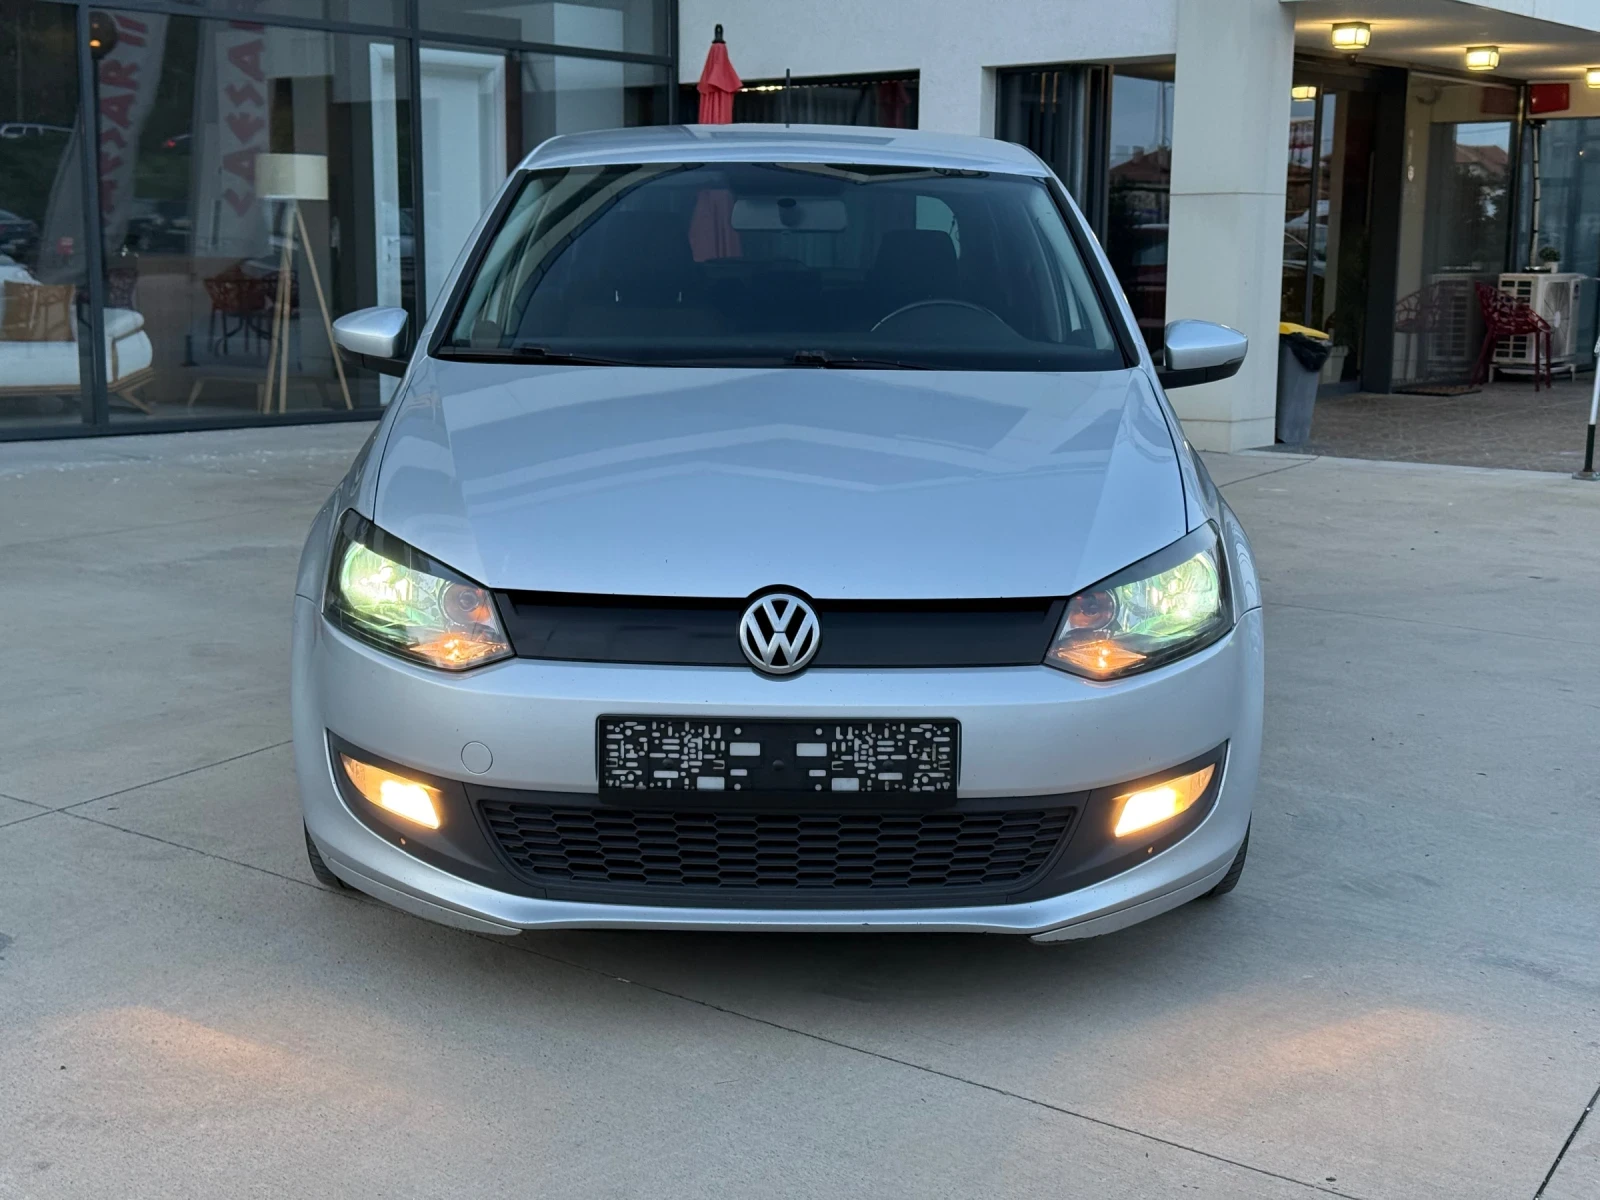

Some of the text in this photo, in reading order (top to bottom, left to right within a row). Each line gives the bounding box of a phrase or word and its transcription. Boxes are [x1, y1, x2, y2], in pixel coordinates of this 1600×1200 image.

[100, 59, 139, 226] ESAR
[222, 20, 265, 217] CAESA
[743, 597, 817, 670] VW
